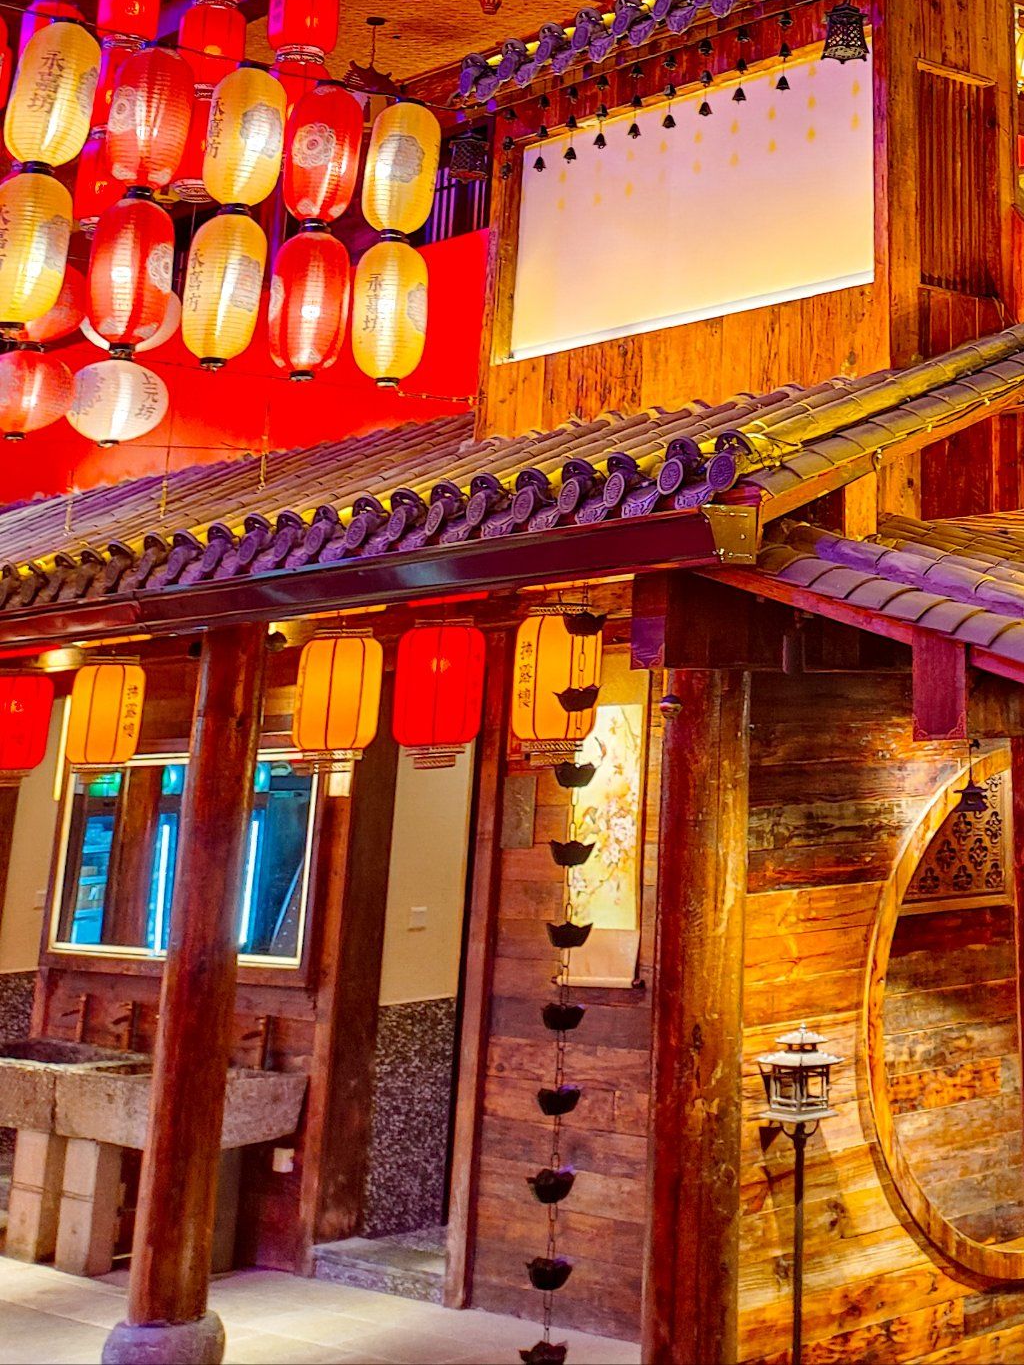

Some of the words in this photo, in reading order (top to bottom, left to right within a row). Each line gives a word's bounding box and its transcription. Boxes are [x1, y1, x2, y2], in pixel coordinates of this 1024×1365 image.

[27, 50, 65, 114] 永嘉坊
[135, 371, 161, 421] 上元坊
